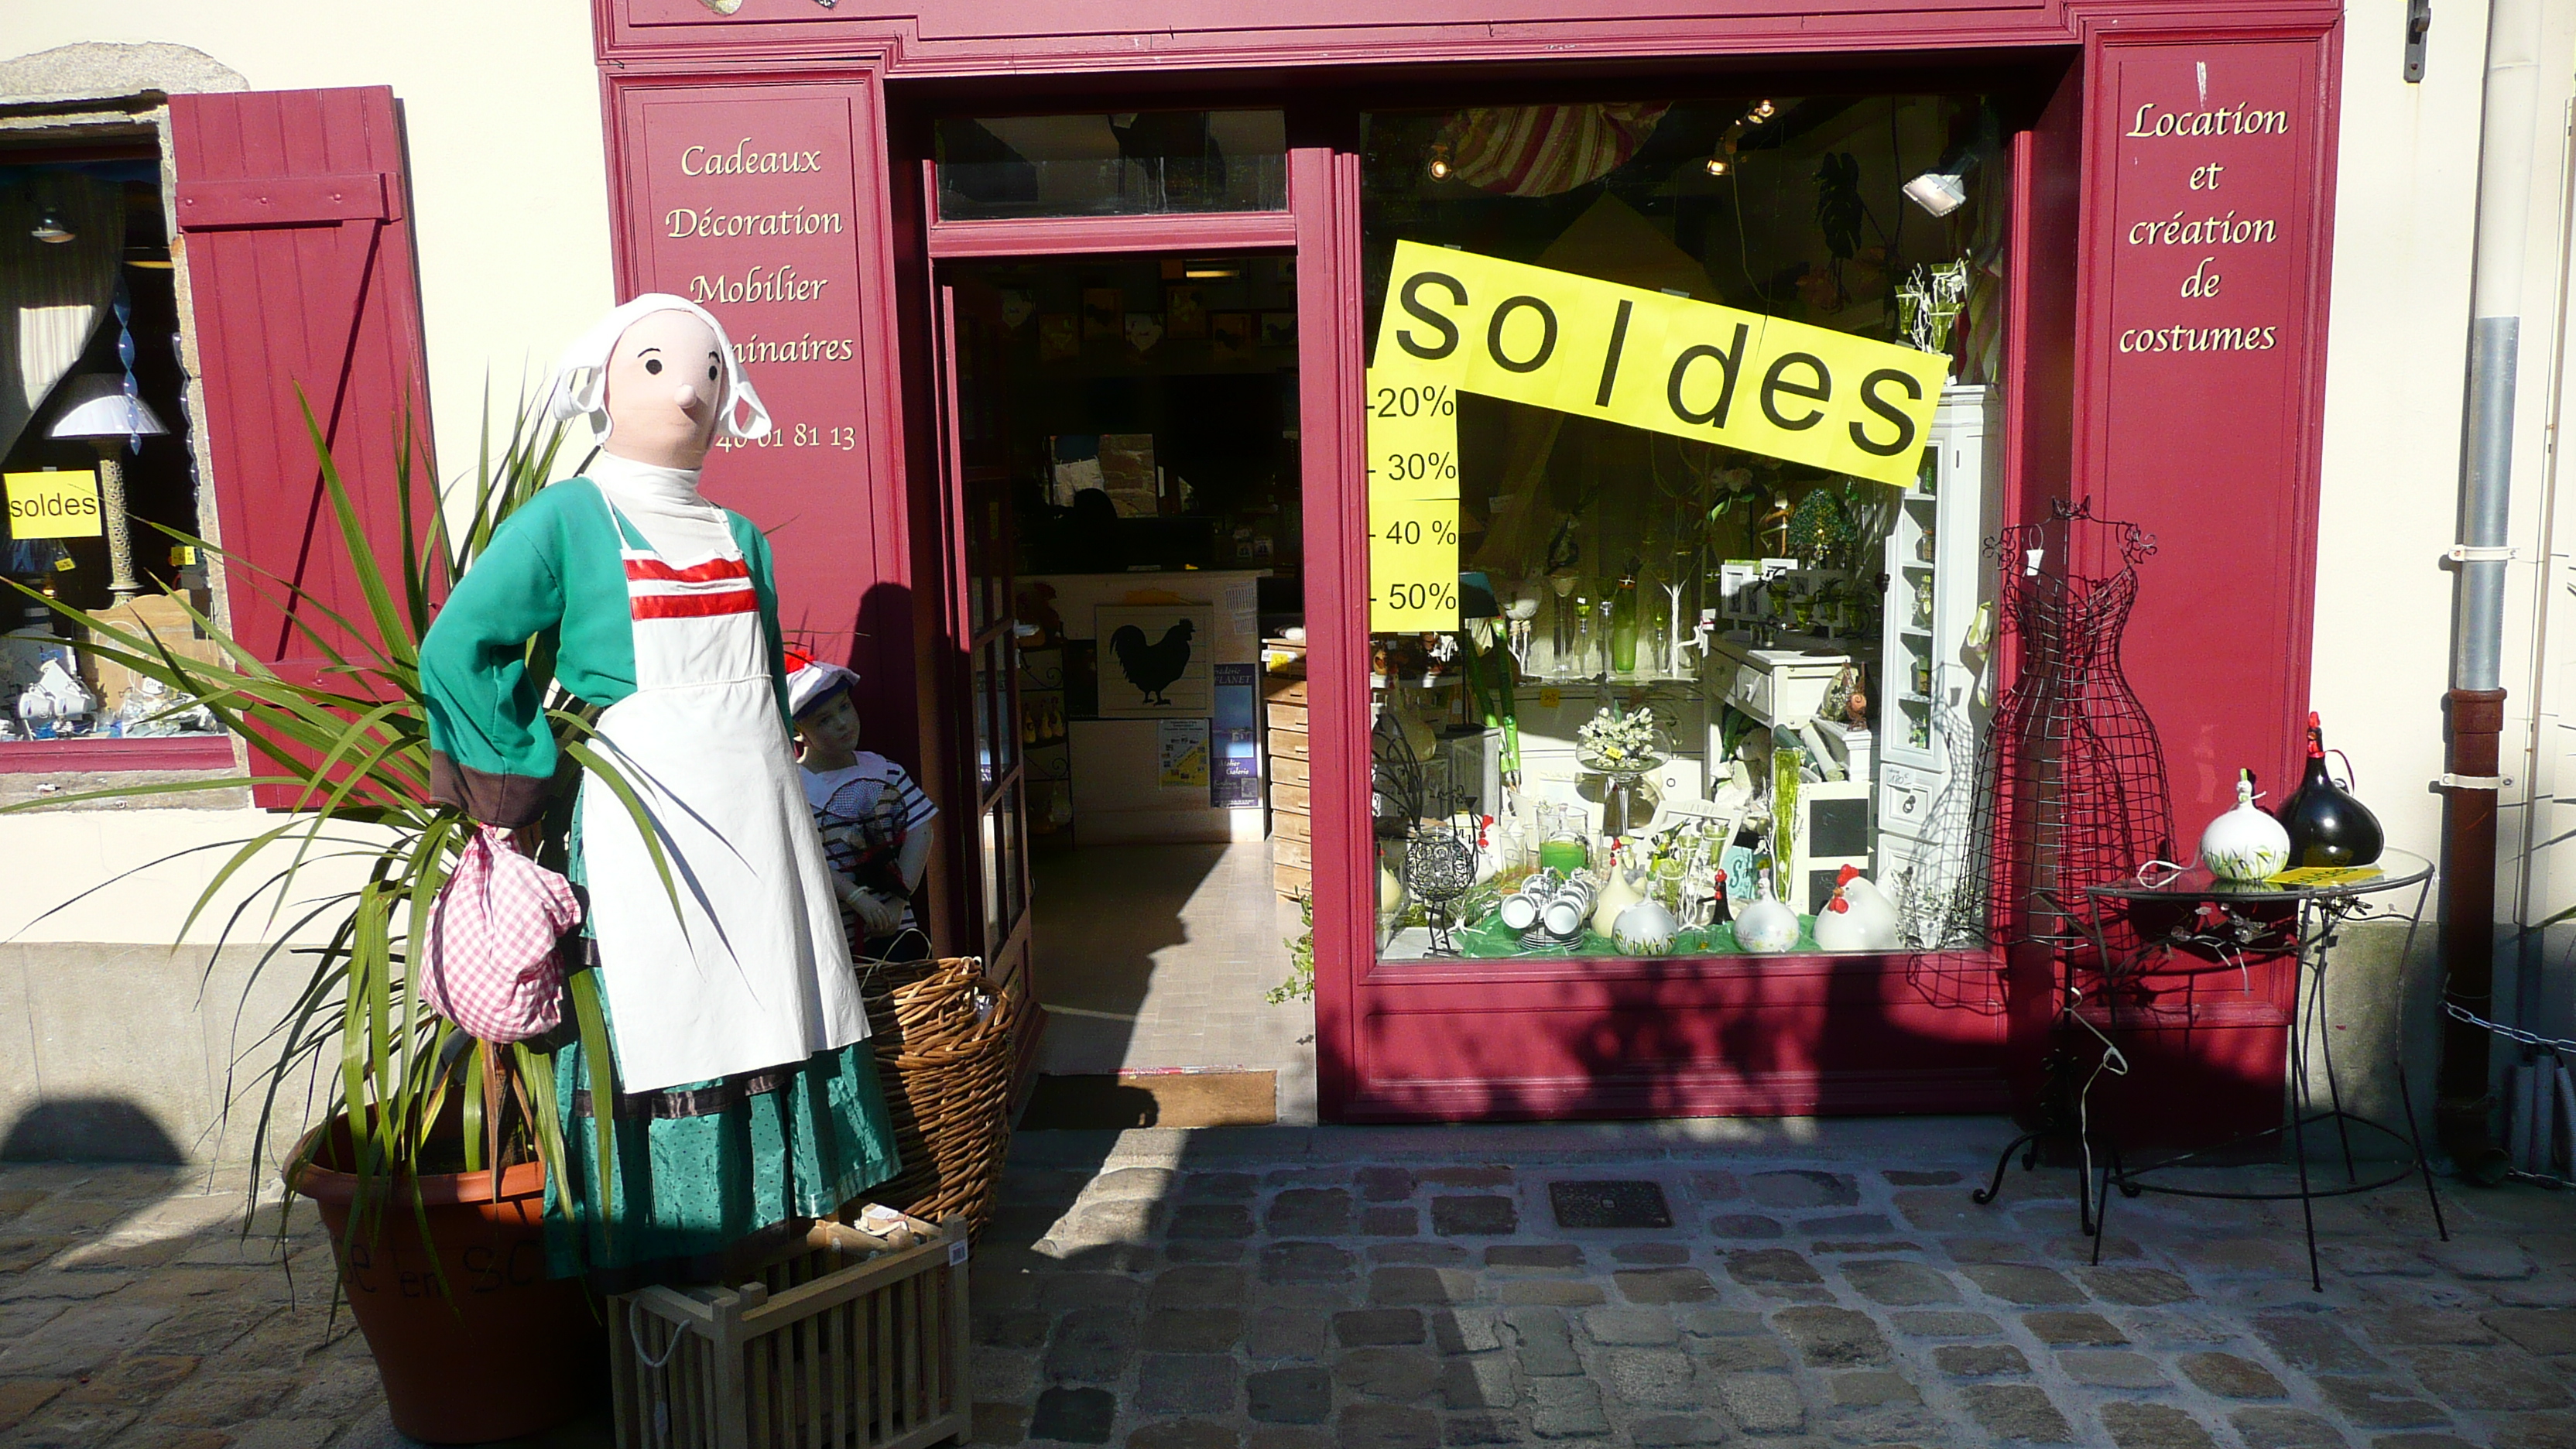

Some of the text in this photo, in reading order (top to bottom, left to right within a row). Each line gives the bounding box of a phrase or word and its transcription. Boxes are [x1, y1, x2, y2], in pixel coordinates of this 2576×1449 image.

[2126, 102, 2289, 137] Location
[681, 137, 821, 176] Cadeaux
[2189, 162, 2224, 190] et
[665, 205, 843, 238] Décoration
[2129, 211, 2277, 245] création
[690, 265, 827, 304] Mobilier
[2180, 257, 2220, 298] de
[2119, 325, 2277, 353] costumes
[1396, 271, 1923, 456] soldes
[1365, 385, 1454, 417] -20%
[793, 423, 820, 447] 81
[831, 427, 855, 450] 13
[10, 492, 97, 517] soldes
